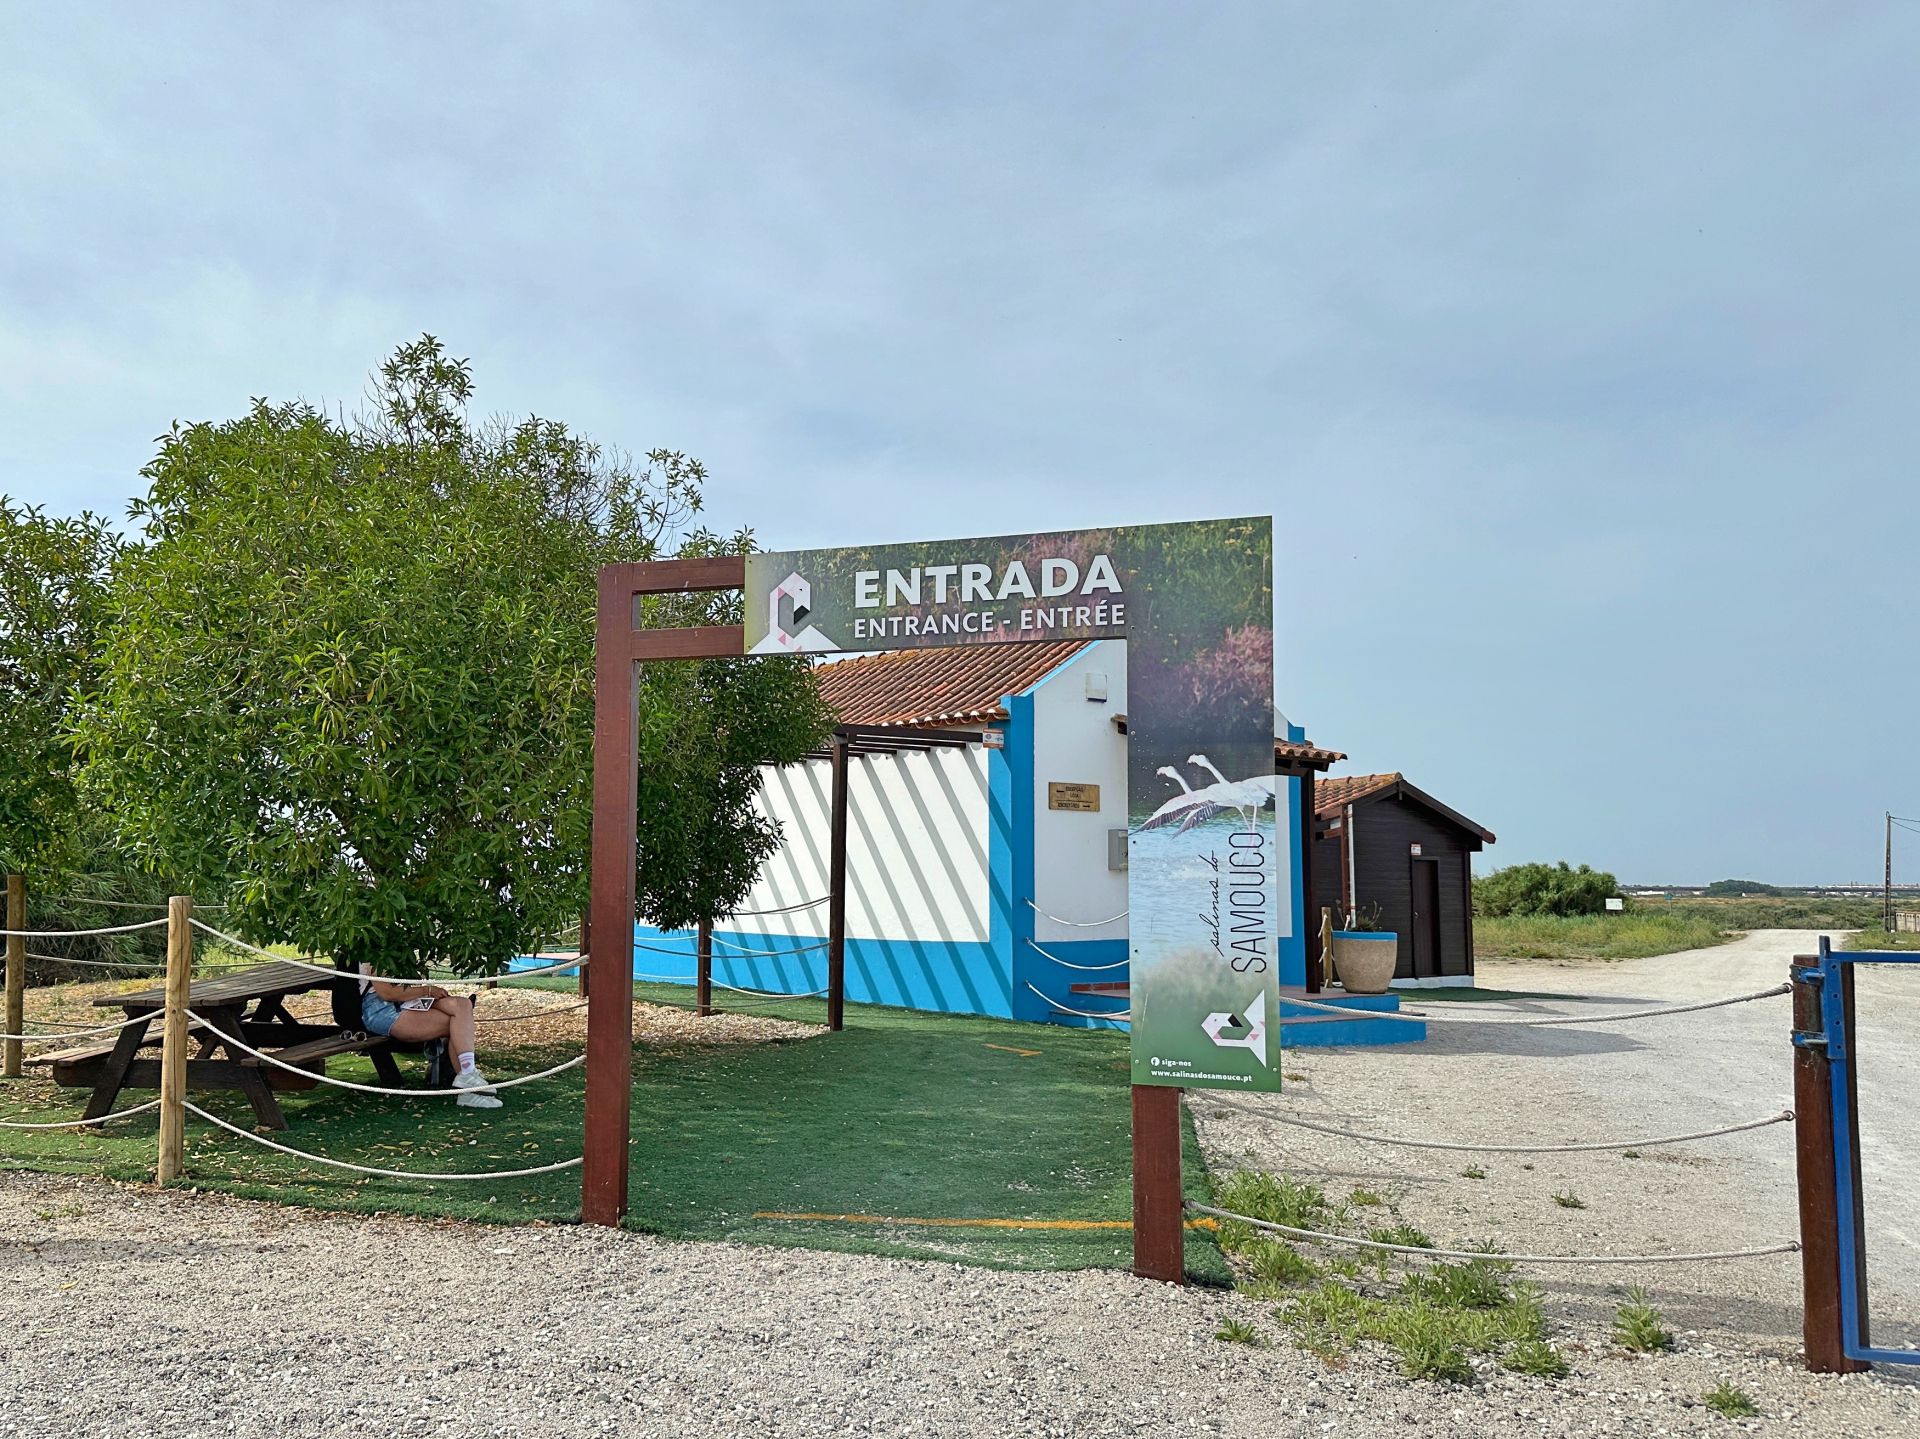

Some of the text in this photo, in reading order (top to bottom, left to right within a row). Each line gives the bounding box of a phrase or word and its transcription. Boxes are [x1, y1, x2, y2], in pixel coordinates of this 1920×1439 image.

[855, 555, 1122, 608] ENTRADA
[854, 611, 994, 638] ENTRANCE
[1020, 600, 1125, 630] ENTRÉE
[1198, 849, 1224, 957] salinas do
[1228, 832, 1267, 973] SAMOUCO
[1151, 1070, 1252, 1082] www.salinasdosamouco.pt
[1161, 1058, 1191, 1067] siga-nos
